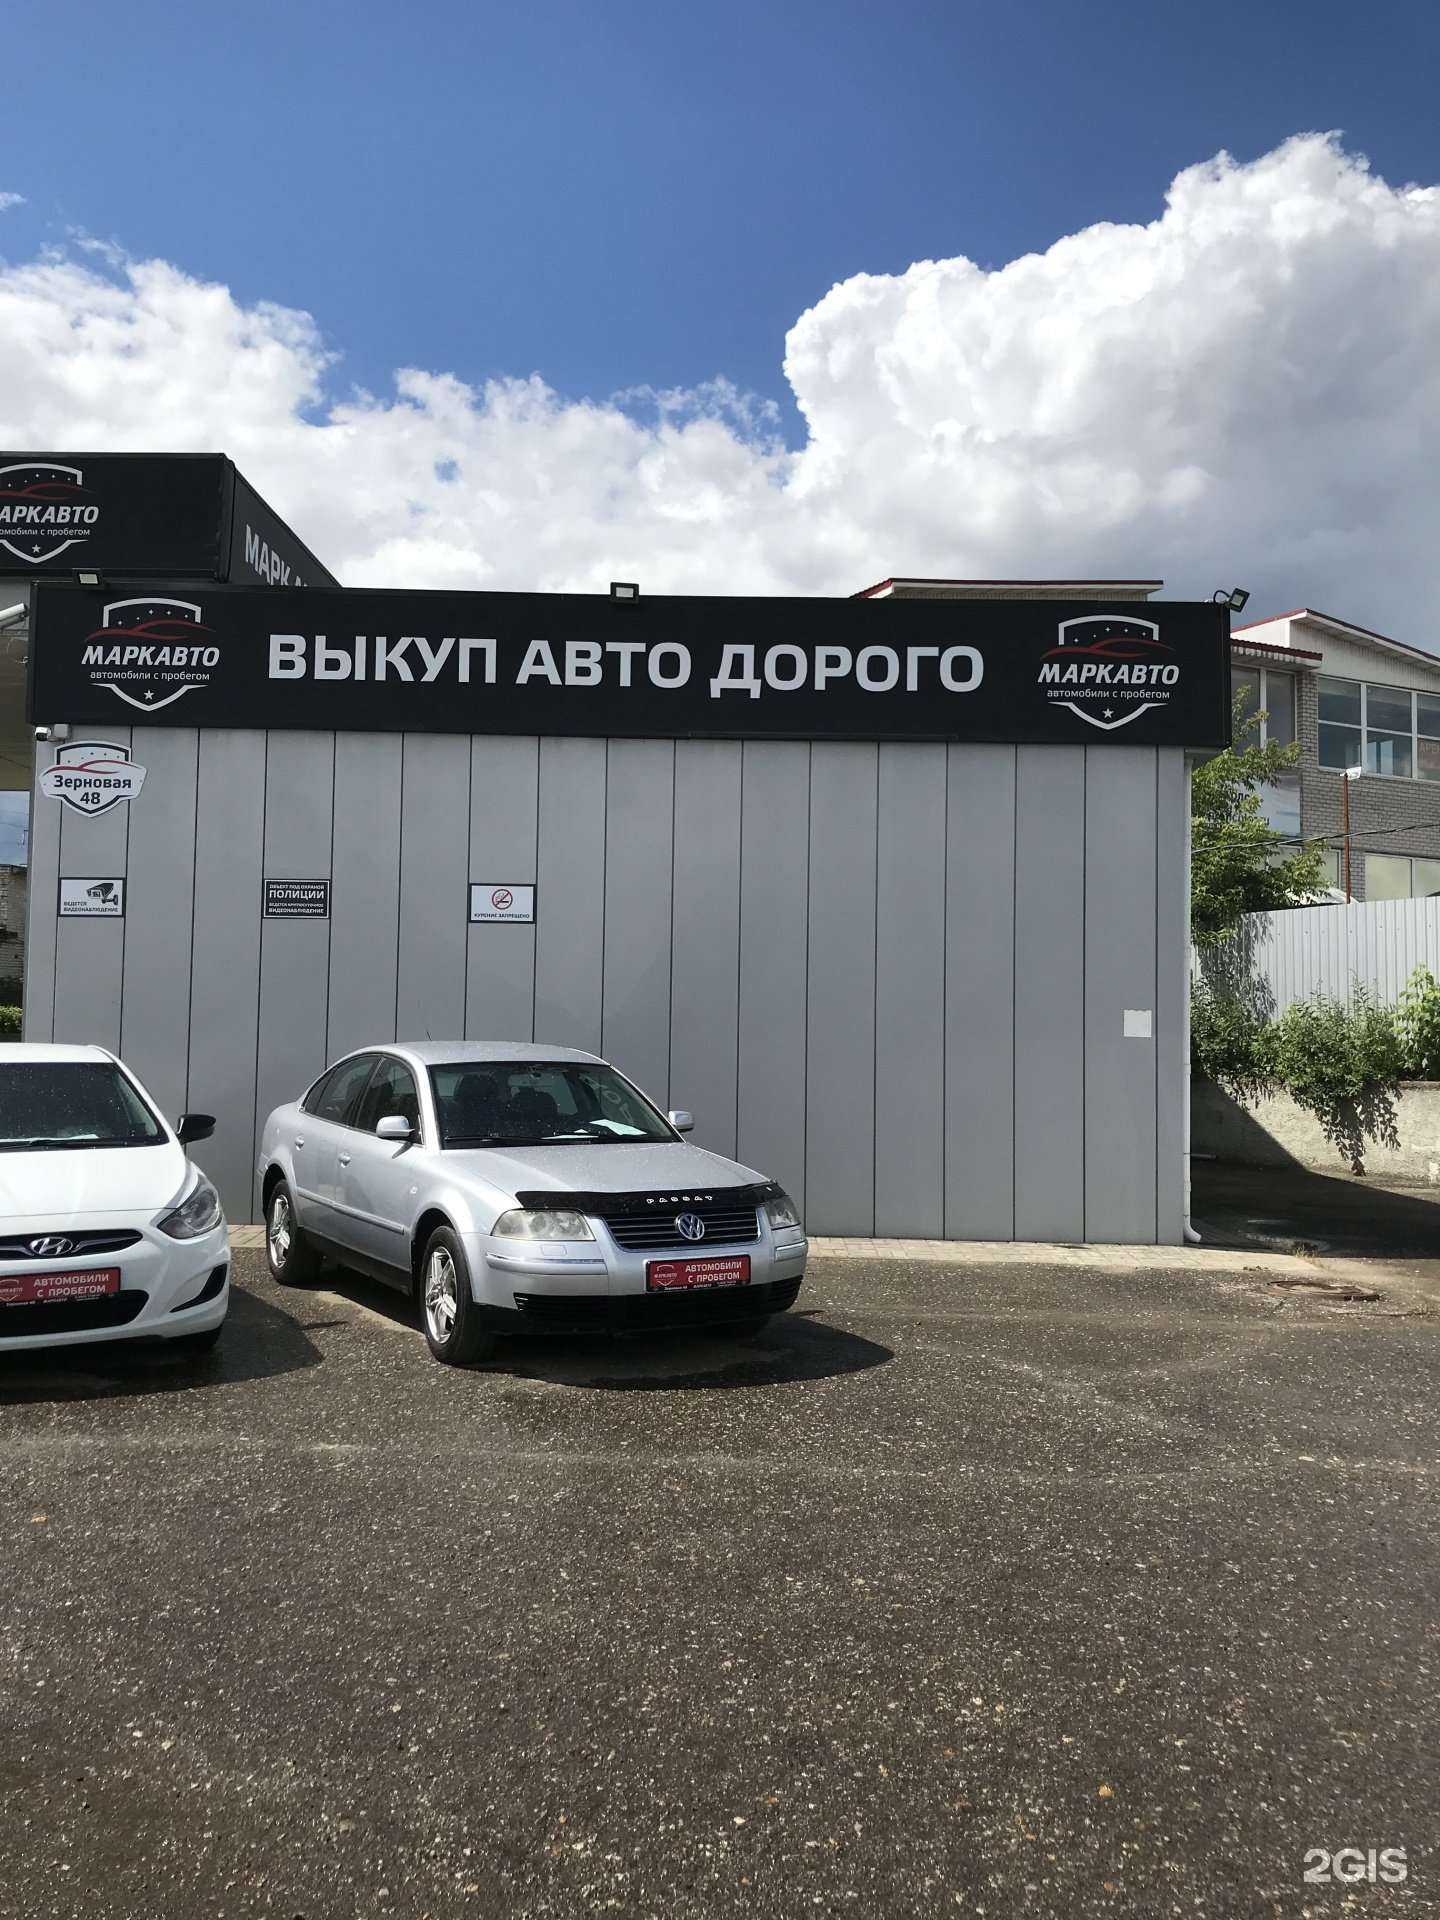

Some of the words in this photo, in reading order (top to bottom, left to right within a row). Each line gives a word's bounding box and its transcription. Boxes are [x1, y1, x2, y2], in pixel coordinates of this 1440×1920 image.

[47, 527, 90, 537] пробегом
[81, 645, 220, 667] МАРКАВТО
[268, 633, 497, 684] ВЫКУП
[515, 639, 691, 689] АВТО
[709, 643, 984, 699] ДОРОГО
[89, 670, 151, 681] автомобили
[153, 672, 159, 681] с
[161, 671, 210, 682] пробегом
[1038, 663, 1180, 685] МАРКАВТО
[1047, 688, 1110, 698] автомобили
[1113, 690, 1118, 698] с
[1120, 689, 1170, 700] пробегом
[54, 774, 132, 791] Зерновая
[80, 791, 101, 805] 48
[269, 890, 324, 900] ПОЛИЦИИ
[685, 1261, 742, 1273] АВТОМОБИЛИ
[33, 1274, 109, 1287] АВТОМОБИЛИ
[687, 1275, 693, 1283] С
[696, 1272, 740, 1282] ПРОБЕГОМ
[37, 1289, 44, 1297] С
[48, 1285, 106, 1297] ПРОБЕГОМ
